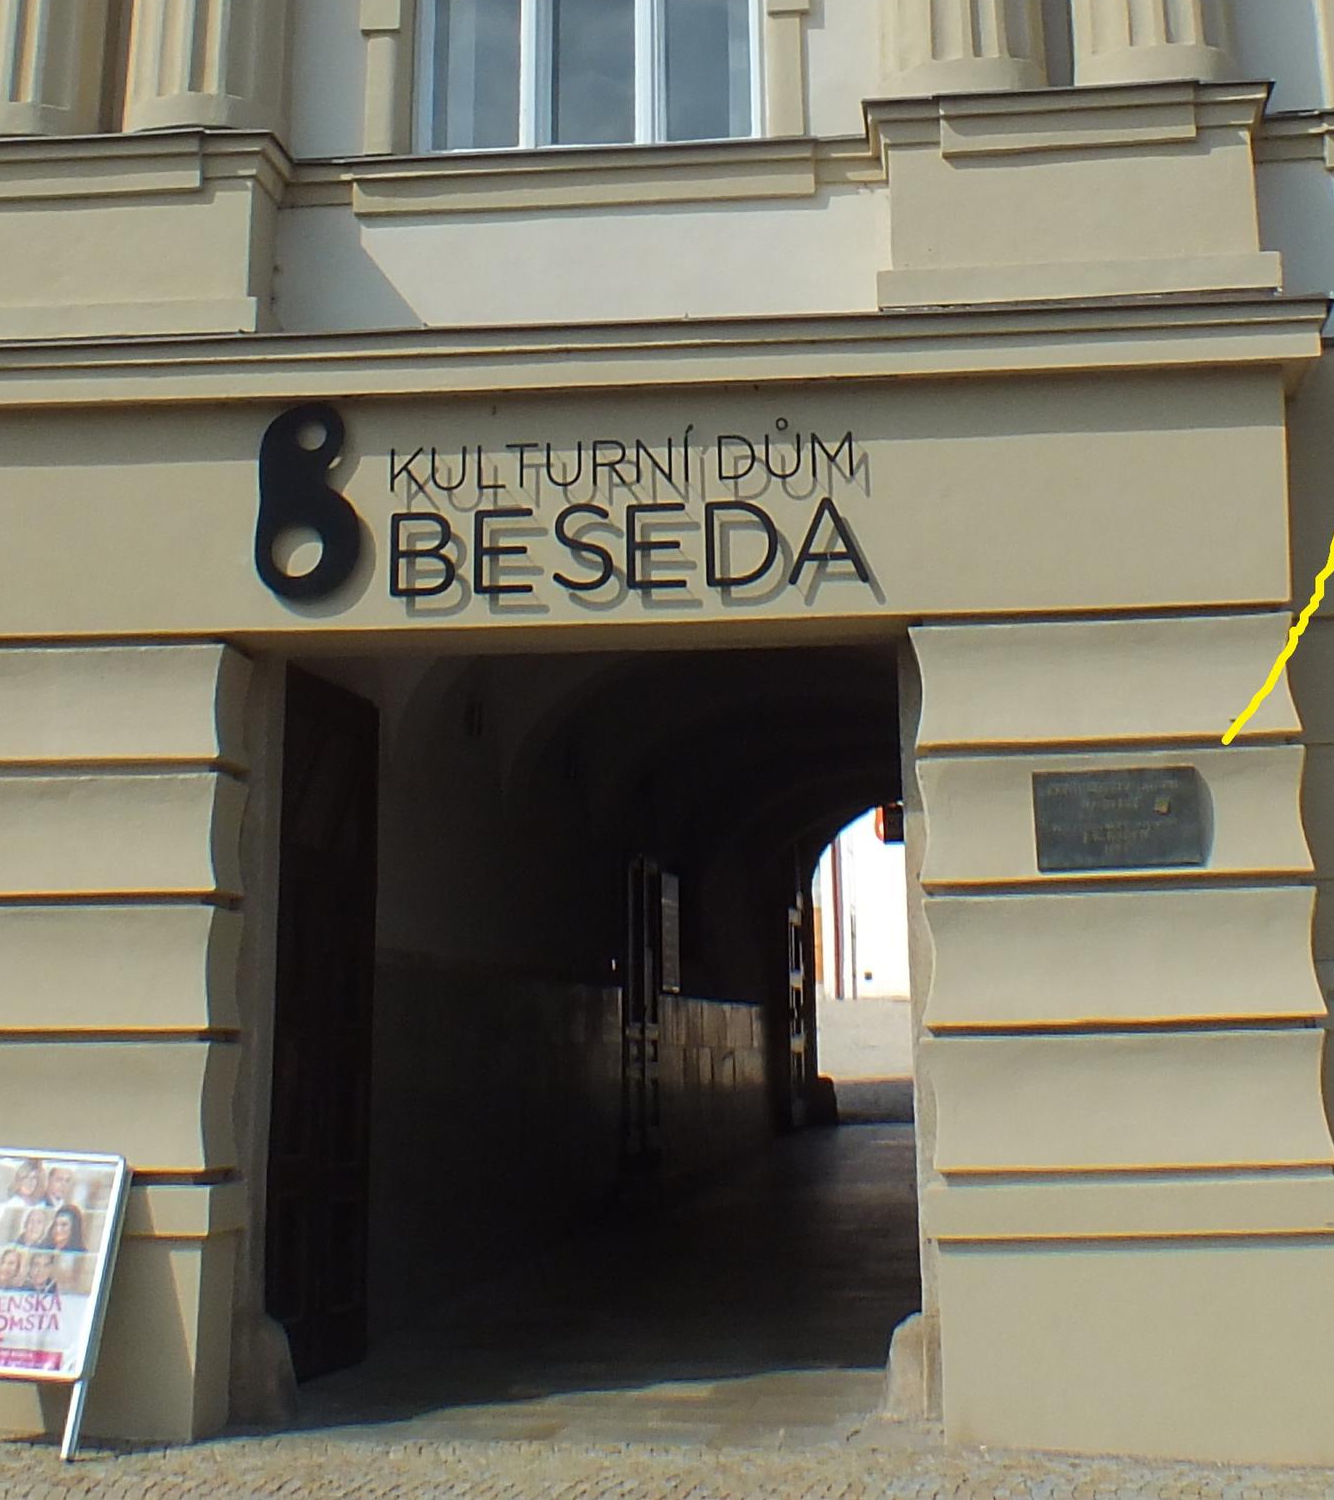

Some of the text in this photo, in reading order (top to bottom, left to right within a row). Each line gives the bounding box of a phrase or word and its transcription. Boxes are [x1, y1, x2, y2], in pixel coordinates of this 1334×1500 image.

[390, 417, 854, 491] KULTURNÍ DŮM
[389, 497, 869, 597] BESEDA
